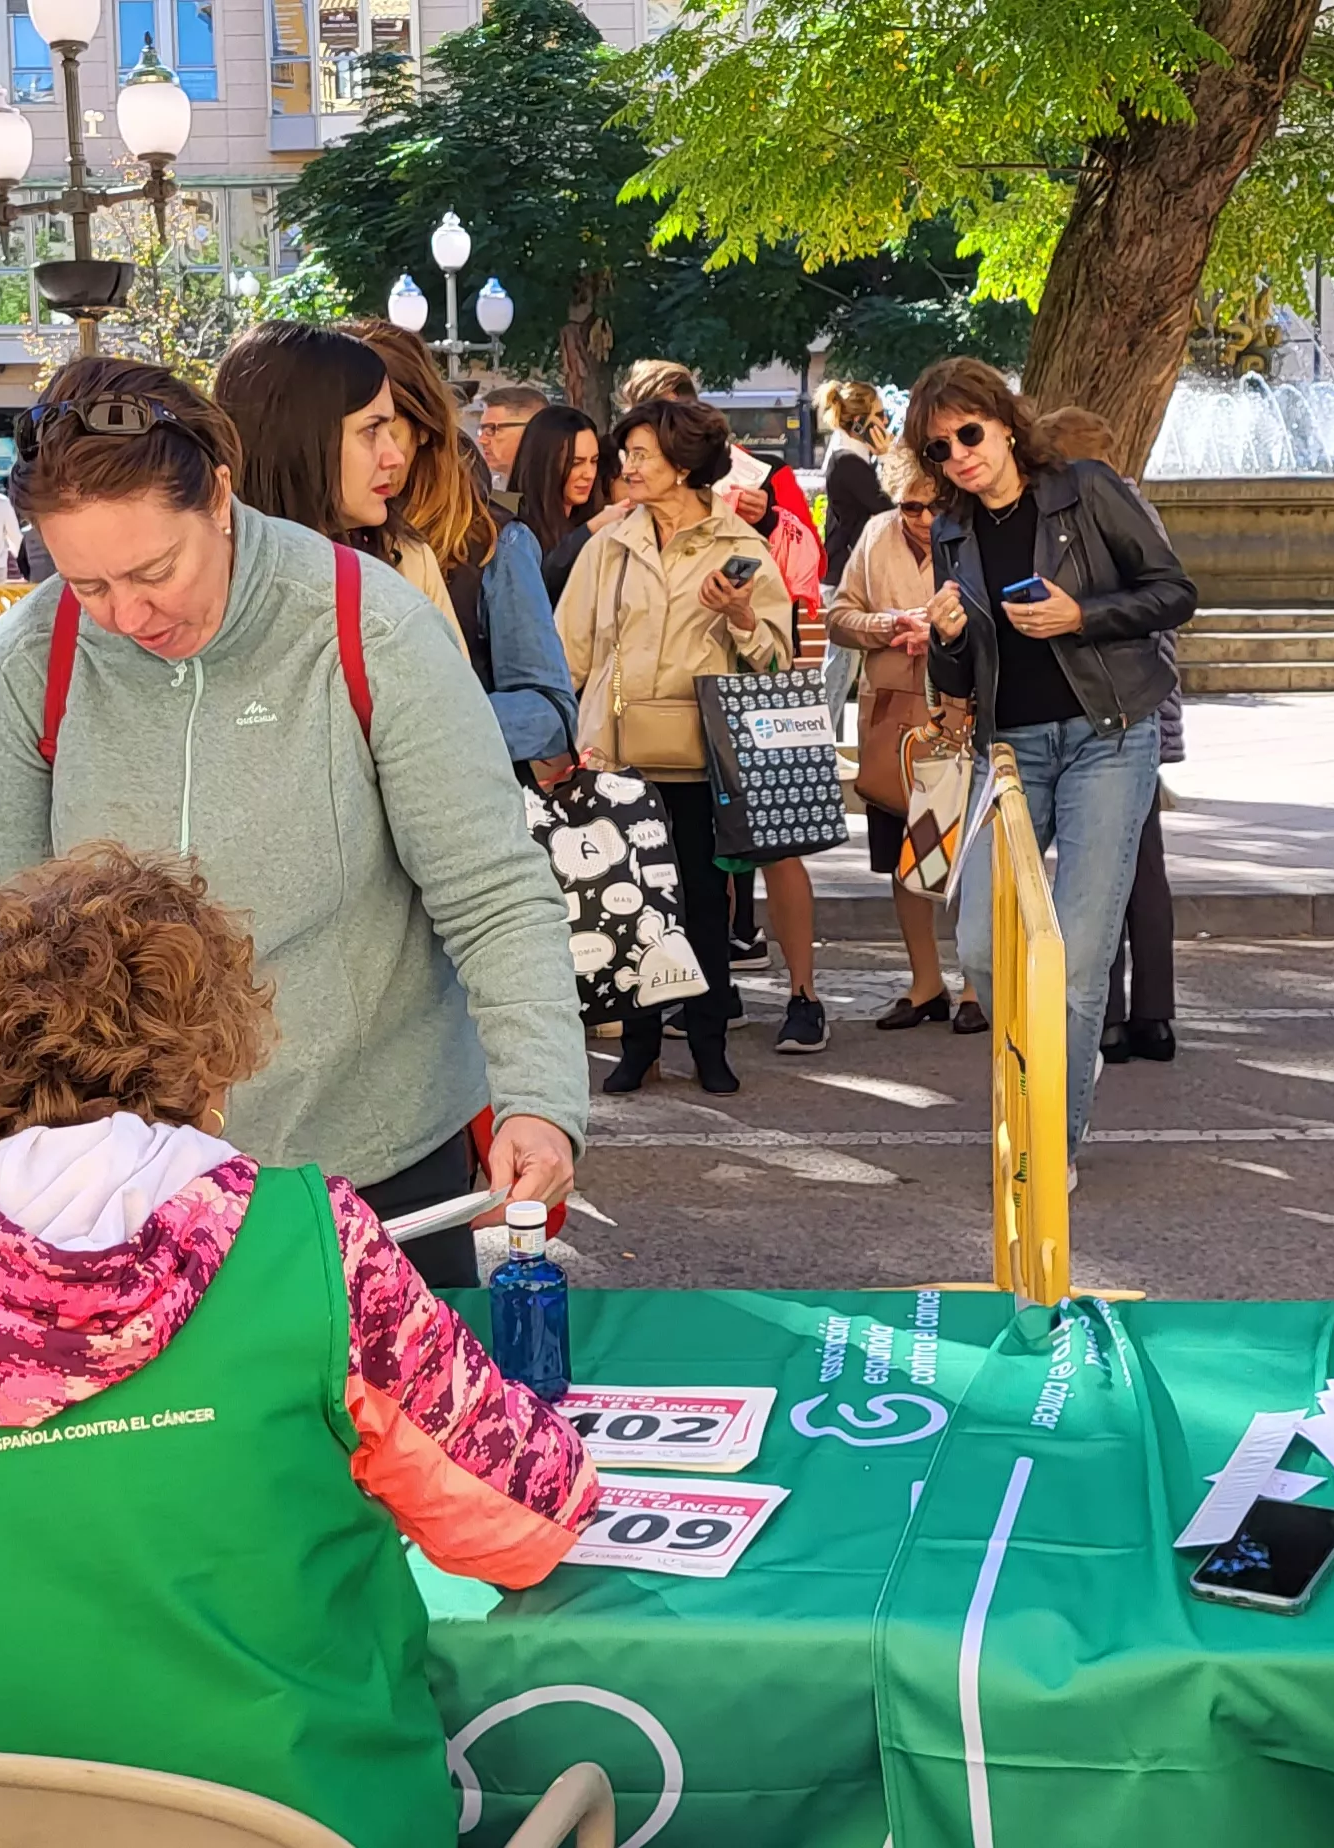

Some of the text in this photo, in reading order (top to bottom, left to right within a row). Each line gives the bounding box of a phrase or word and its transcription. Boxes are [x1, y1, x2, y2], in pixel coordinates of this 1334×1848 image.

[637, 828, 662, 842] MAN
[613, 896, 633, 904] MAN
[650, 968, 701, 989] élite
[906, 1328, 938, 1341] el
[814, 1315, 852, 1383] asociación
[862, 1323, 900, 1385] española
[904, 1341, 938, 1385] contra
[561, 1399, 728, 1414] TRA EL CÁNCER
[591, 1394, 656, 1404] HUESCA
[1029, 1381, 1076, 1431] cáncer
[64, 1420, 129, 1441] CONTRA
[130, 1416, 151, 1431] EL
[152, 1407, 215, 1428] CÁNCER
[602, 1488, 672, 1501] HUESCA
[619, 1497, 644, 1508] EL
[650, 1498, 747, 1516] CÁNCER
